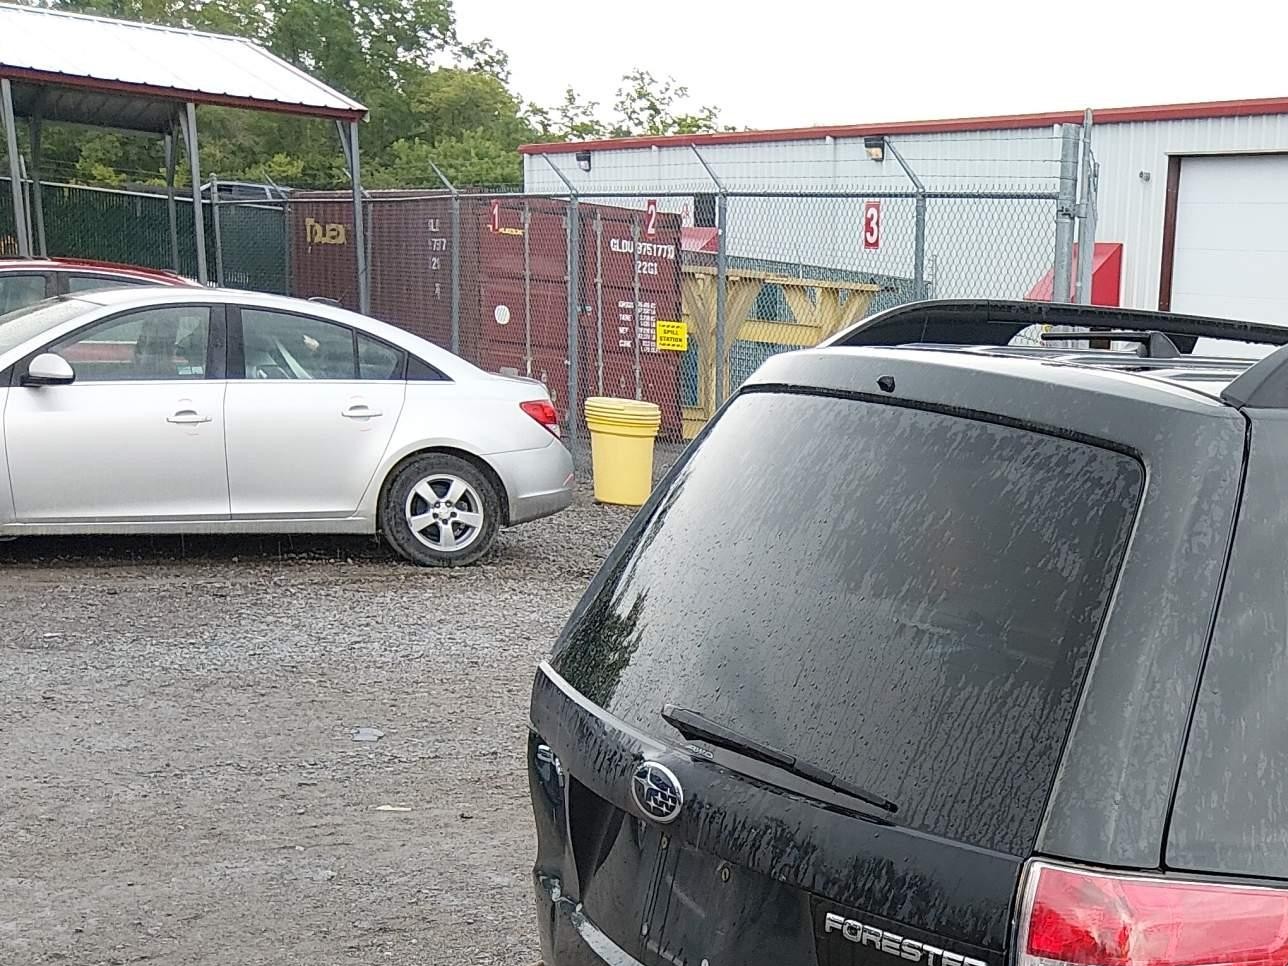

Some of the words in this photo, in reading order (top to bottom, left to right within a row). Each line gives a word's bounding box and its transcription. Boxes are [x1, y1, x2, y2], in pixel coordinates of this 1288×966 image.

[493, 204, 499, 230] 1
[647, 204, 656, 234] 2
[866, 207, 878, 243] 3
[610, 238, 634, 253] GLDU
[685, 744, 714, 759] AWD
